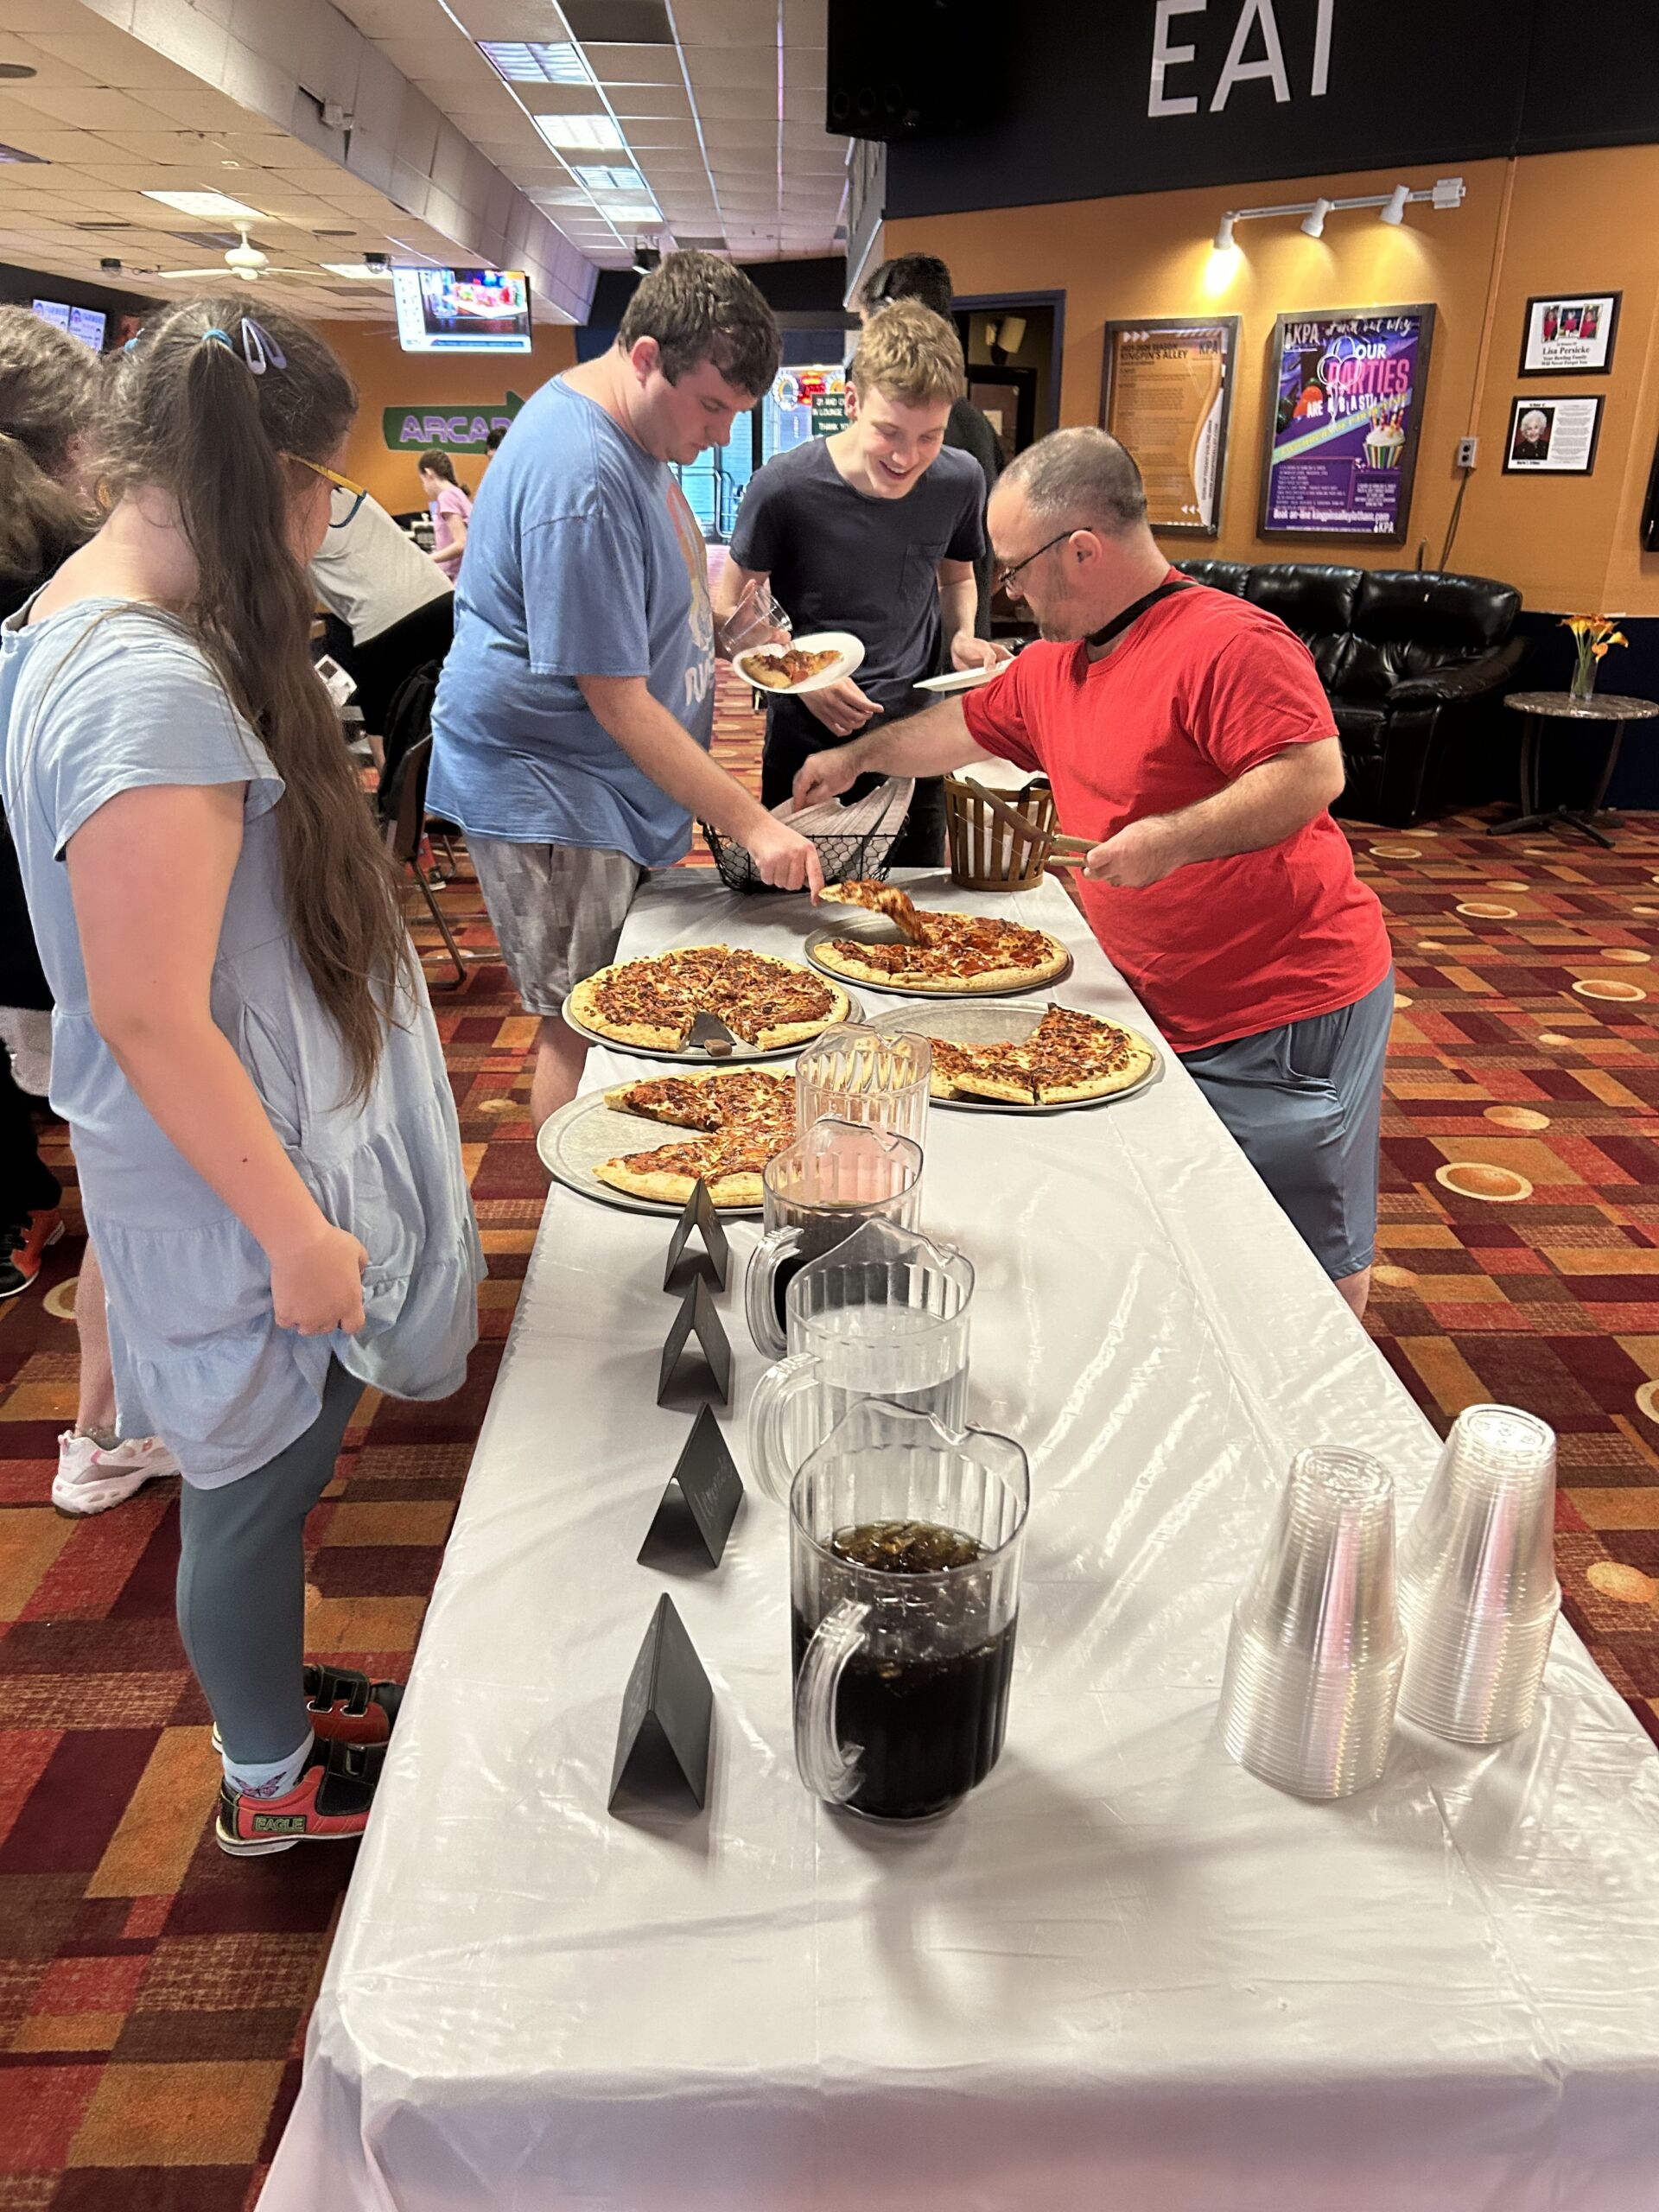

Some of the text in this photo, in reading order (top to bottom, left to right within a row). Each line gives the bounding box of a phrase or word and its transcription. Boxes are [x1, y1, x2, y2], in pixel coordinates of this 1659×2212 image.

[1294, 323, 1319, 346] KPA
[1162, 349, 1188, 359] ALLEY
[1356, 342, 1386, 359] OUR
[1327, 359, 1410, 396] PARTIES
[1306, 400, 1324, 418] ARE
[255, 1817, 305, 1832] EAGLE
